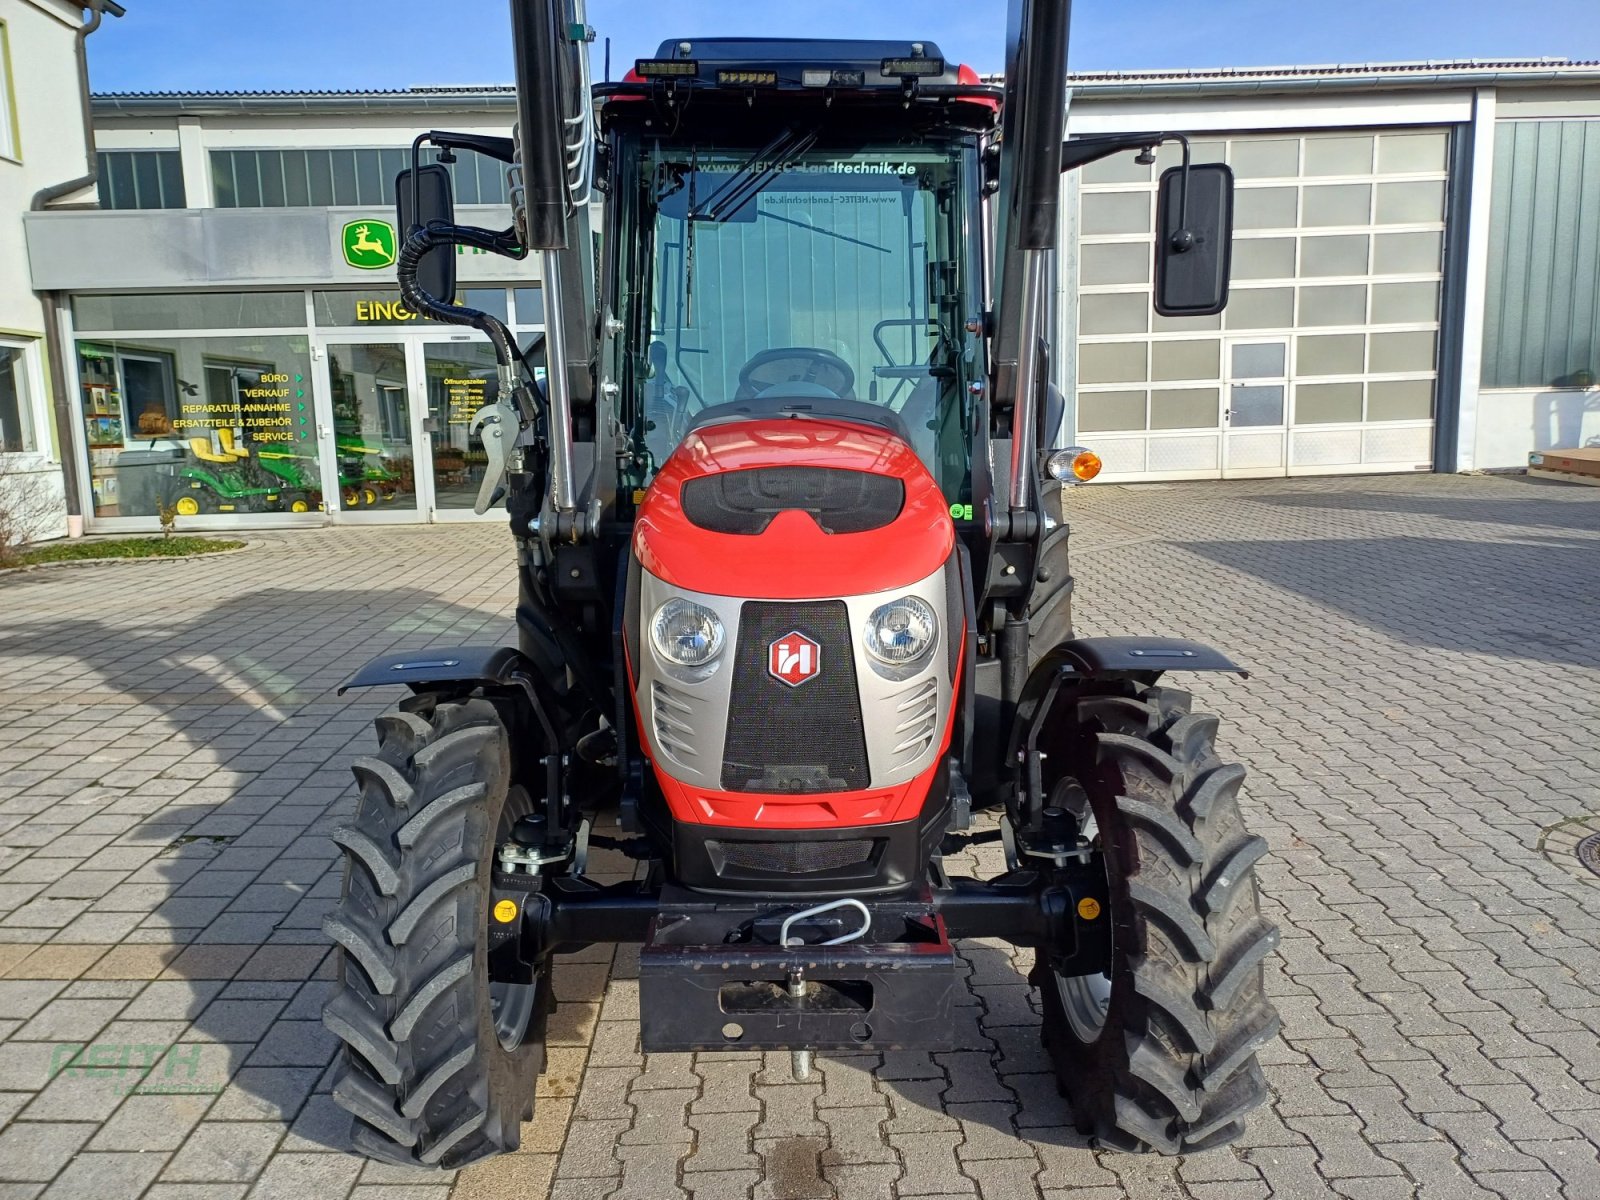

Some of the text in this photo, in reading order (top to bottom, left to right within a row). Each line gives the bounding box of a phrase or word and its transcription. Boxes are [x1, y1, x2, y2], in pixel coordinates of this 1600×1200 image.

[356, 301, 463, 320] EING
[260, 373, 289, 383] BÜRO
[244, 388, 290, 398] VERKAUF
[182, 403, 292, 413] REPARATUR-ANNAHME
[173, 417, 292, 428] ERSATZTEILE & ZUBEHÖR
[252, 432, 294, 441] SERVICE
